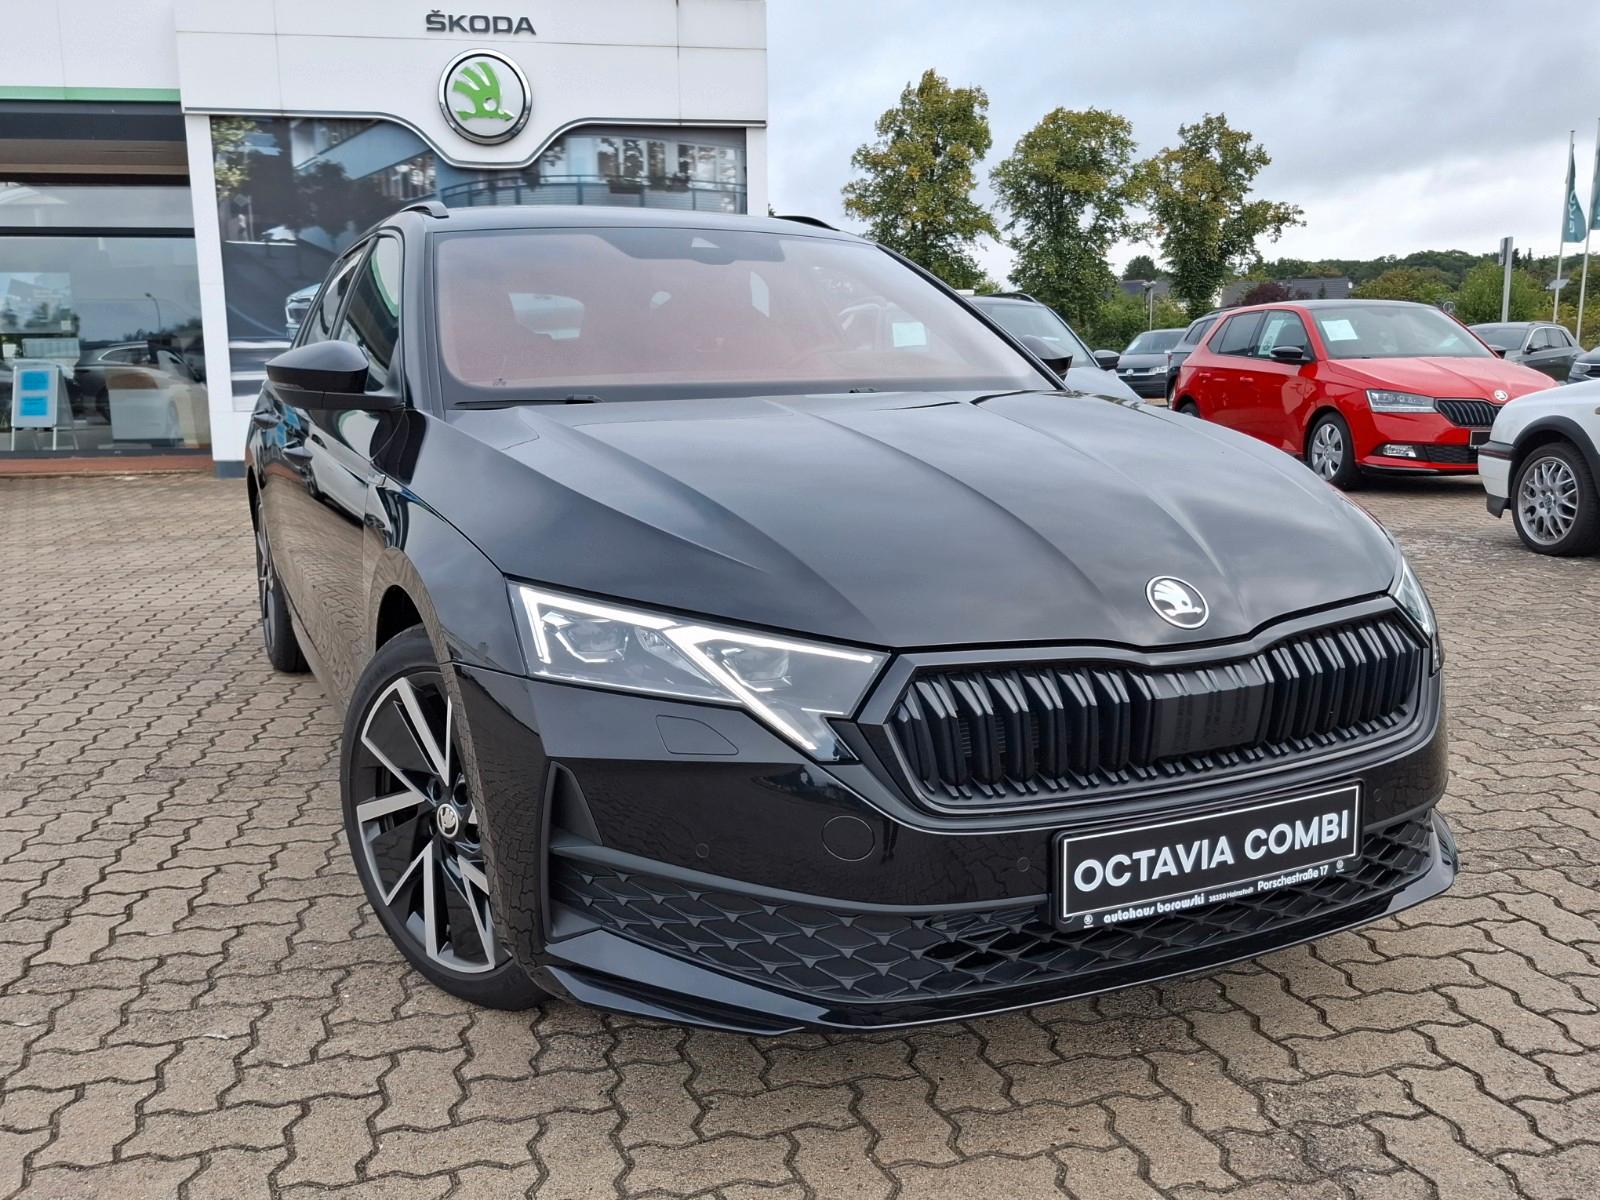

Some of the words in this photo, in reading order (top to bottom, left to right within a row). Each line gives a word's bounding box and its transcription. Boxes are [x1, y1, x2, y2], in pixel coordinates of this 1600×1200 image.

[425, 9, 536, 35] ŠKODA
[1073, 835, 1235, 893] OCTAVIA
[1244, 810, 1349, 860] COMBI
[1103, 905, 1155, 924] autohaus
[1156, 893, 1205, 913] borowski
[1257, 868, 1319, 892] Porschestraße
[1319, 864, 1329, 876] 17
